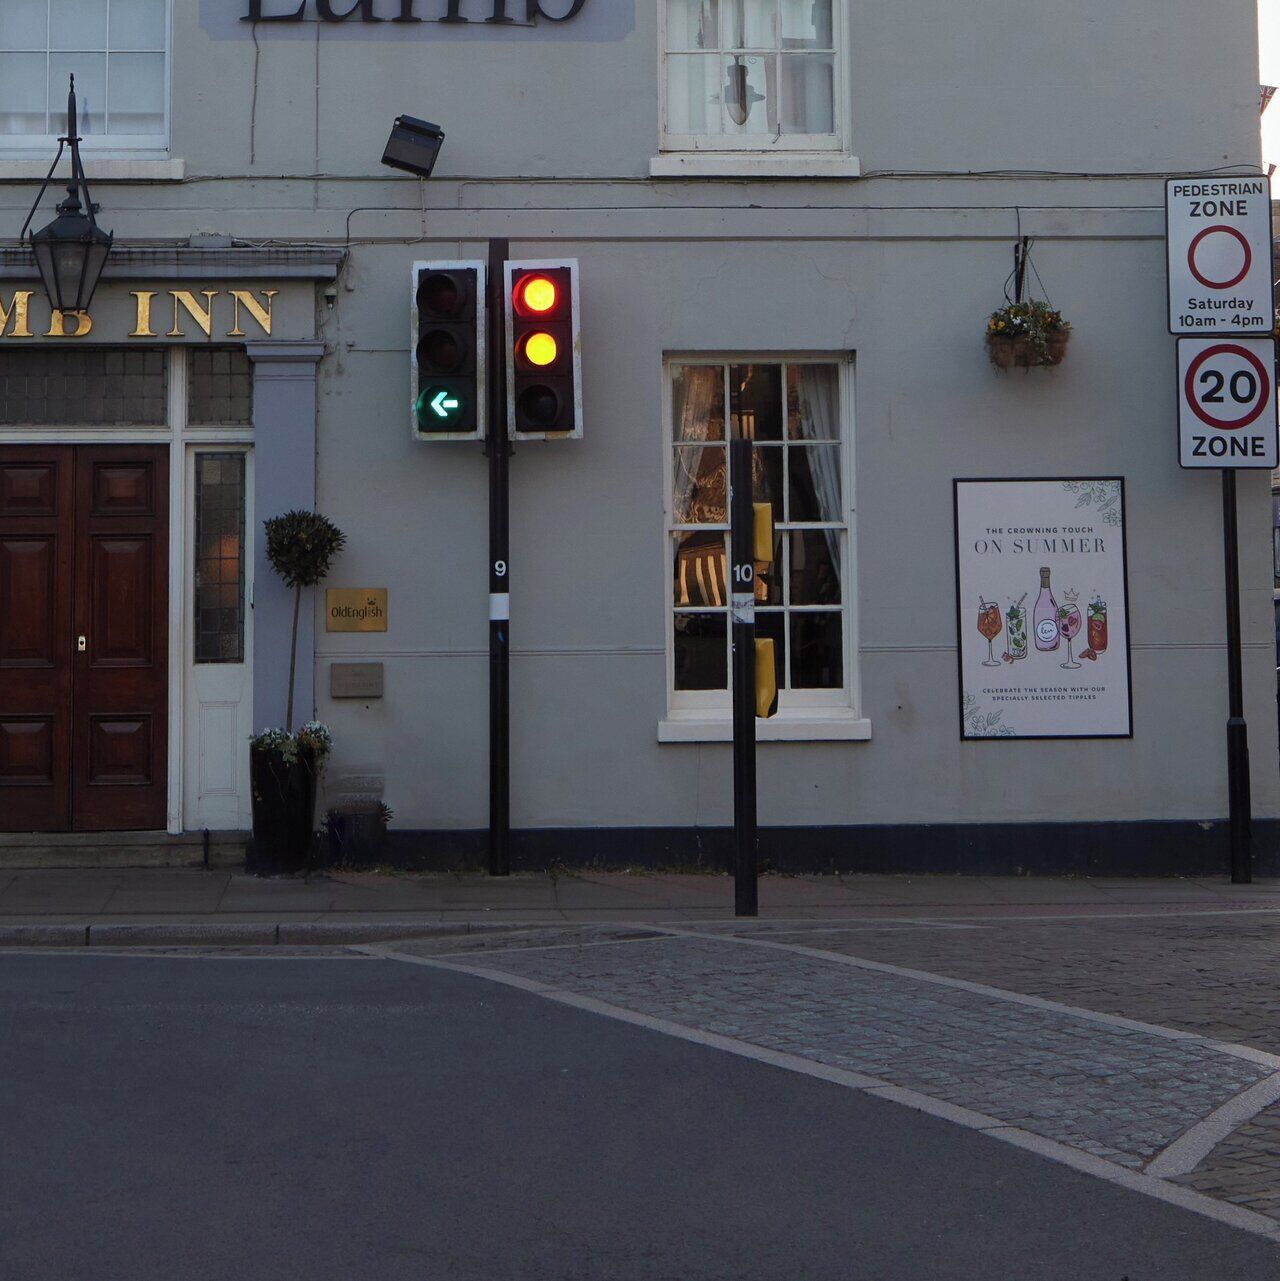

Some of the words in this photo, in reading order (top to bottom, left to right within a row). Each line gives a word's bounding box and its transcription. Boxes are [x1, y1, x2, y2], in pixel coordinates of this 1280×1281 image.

[1174, 183, 1263, 197] PEDESTRIAN
[1189, 200, 1248, 217] ZONE
[1188, 298, 1254, 311] Saturday
[128, 290, 280, 338] INN
[1178, 315, 1217, 327] 10am
[1231, 314, 1264, 328] 4pm
[1200, 370, 1257, 404] 20
[1192, 436, 1266, 457] ZONE
[974, 540, 1002, 554] ON
[1013, 538, 1106, 554] SUMMER
[494, 560, 506, 576] 9
[733, 564, 753, 582] 10
[332, 606, 383, 620] OldEnglish
